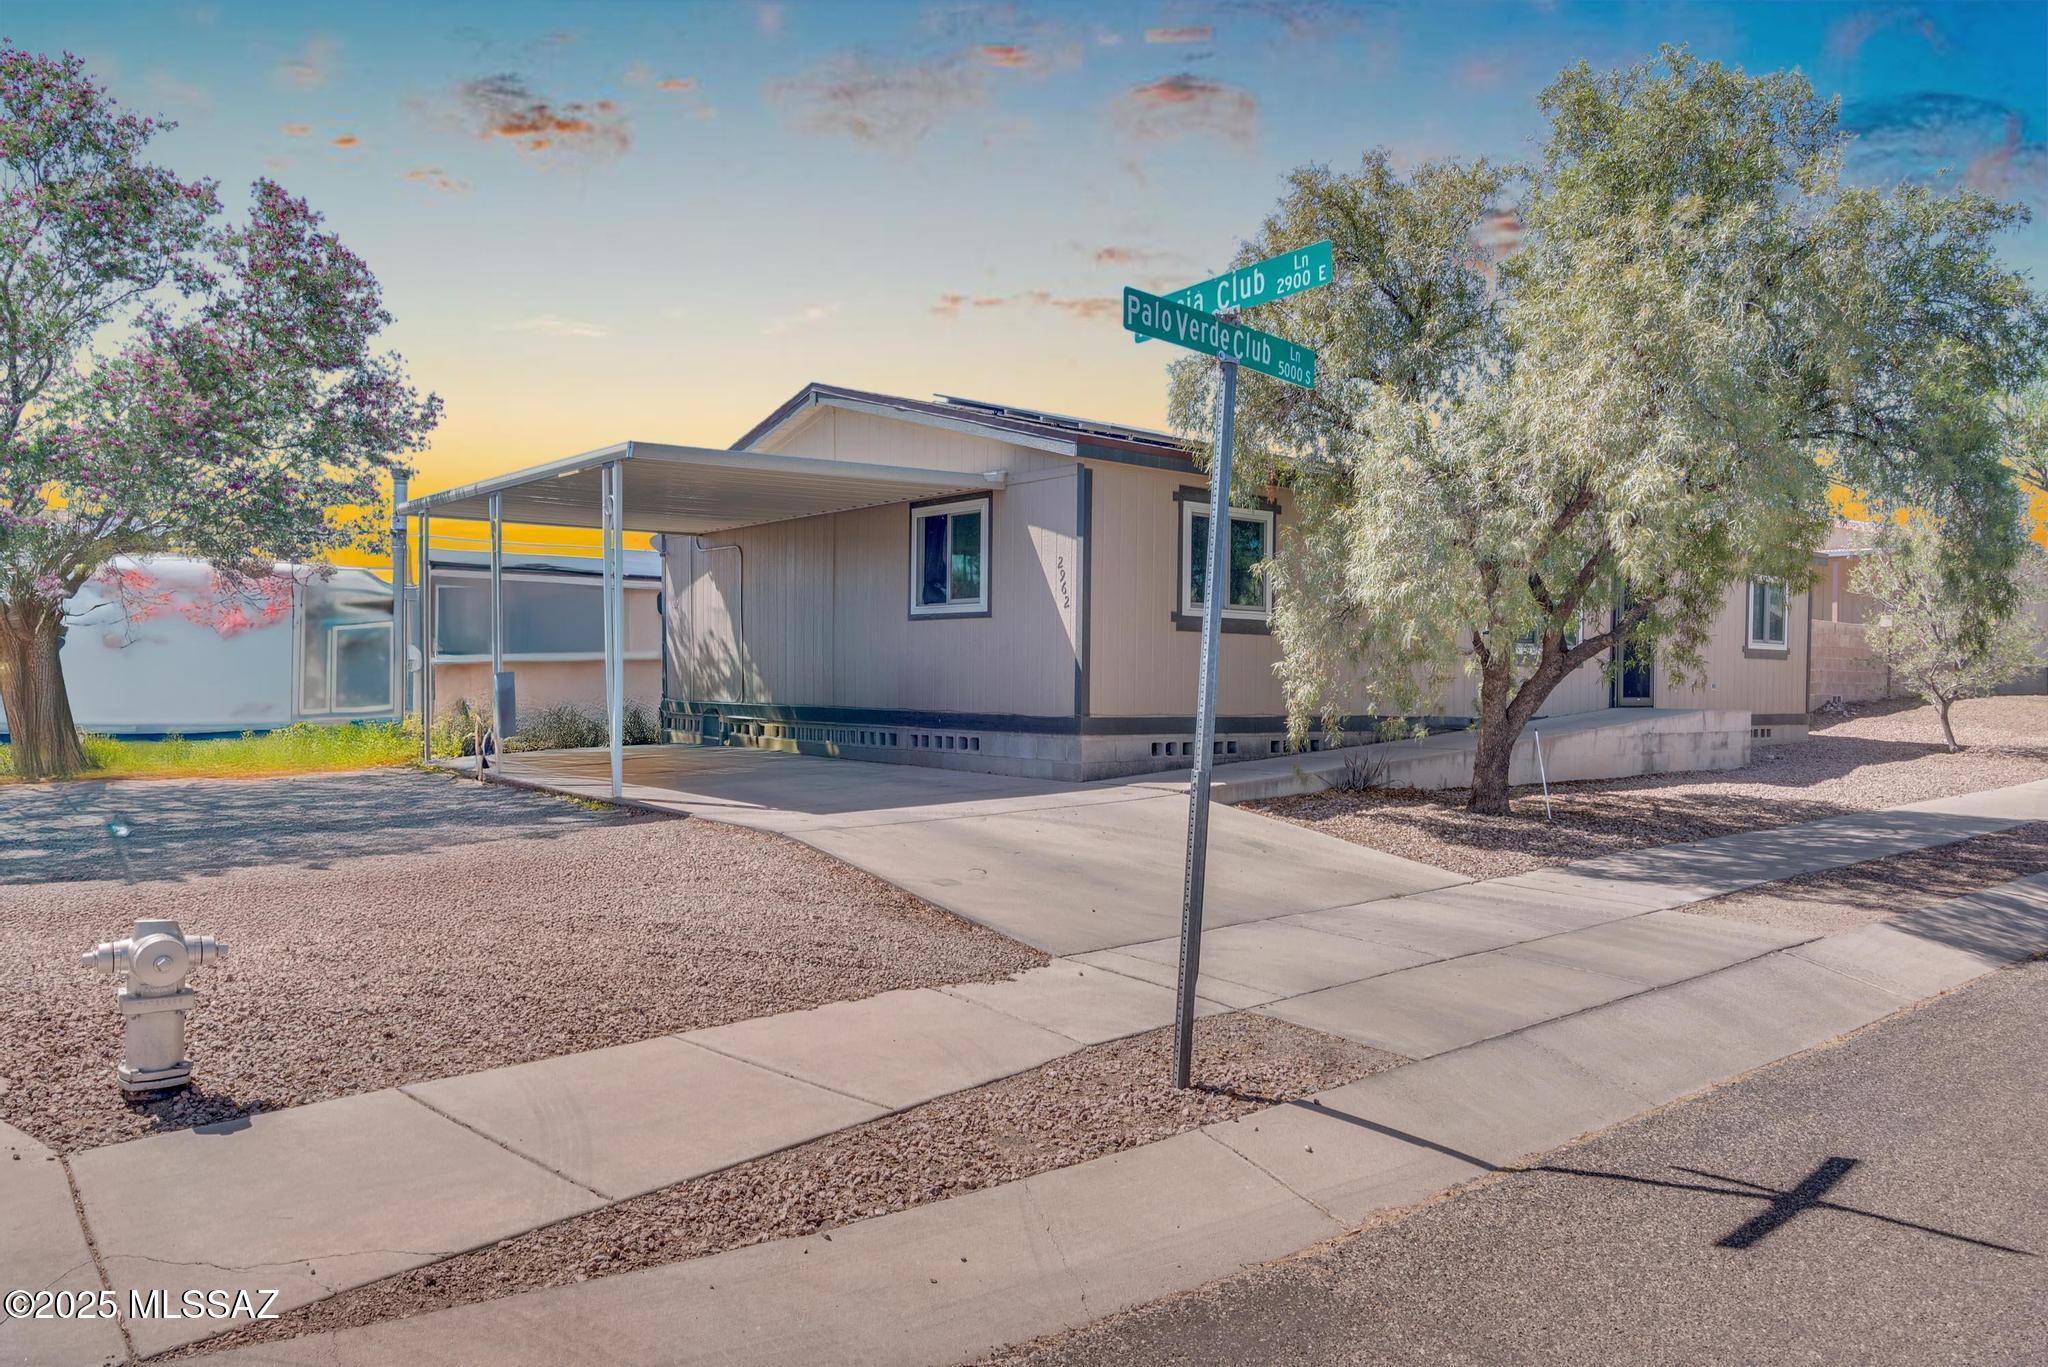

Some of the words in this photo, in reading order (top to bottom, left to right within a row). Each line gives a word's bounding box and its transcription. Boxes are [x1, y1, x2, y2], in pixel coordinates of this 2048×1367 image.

[1217, 268, 1265, 310] Club
[1294, 254, 1309, 270] Ln
[1277, 270, 1310, 294] 2900
[1319, 265, 1326, 281] E
[1127, 294, 1172, 332] Palo
[1176, 311, 1230, 351] Verde
[1233, 330, 1271, 365] Club
[1290, 345, 1300, 362] Ln
[1278, 360, 1304, 382] 5000
[1305, 371, 1311, 385] S
[1057, 556, 1069, 608] 2962
